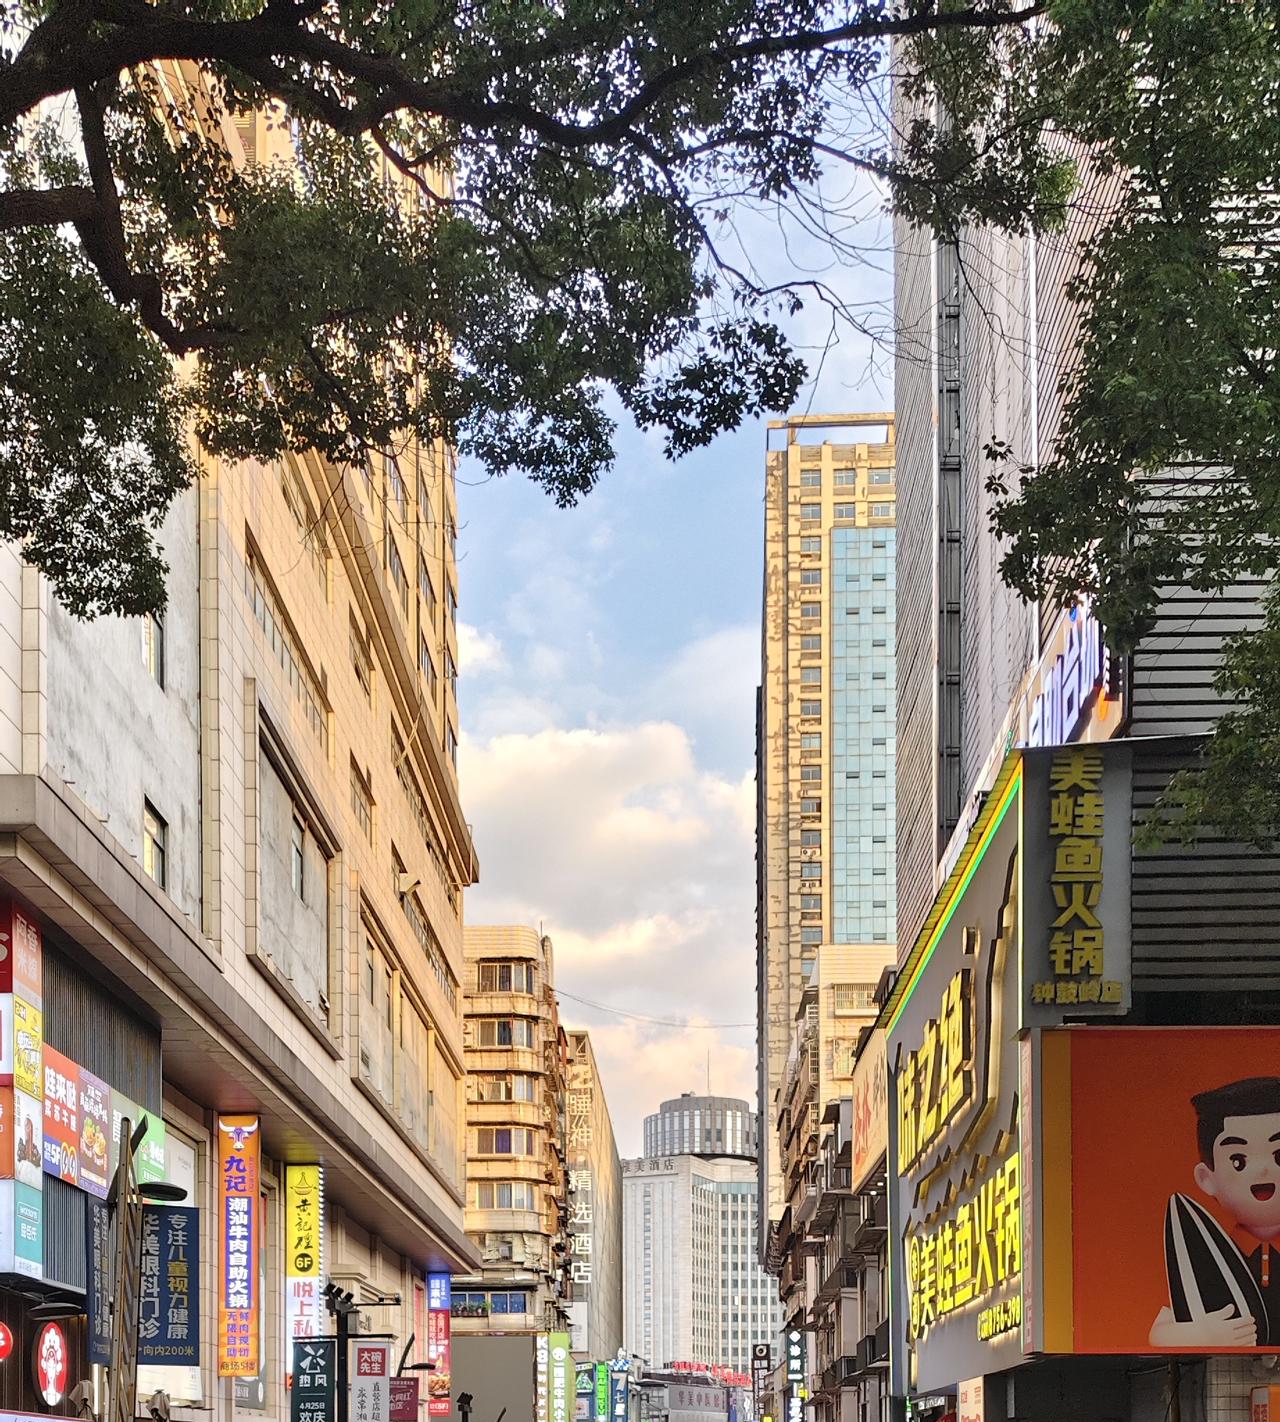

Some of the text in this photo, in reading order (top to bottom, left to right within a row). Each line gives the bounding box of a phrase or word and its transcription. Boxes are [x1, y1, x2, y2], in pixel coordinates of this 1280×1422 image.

[1049, 751, 1104, 975] 美蛙鱼火锅
[224, 1155, 247, 1192] 九记
[228, 1197, 249, 1308] 潮汕牛肉自助火锅
[568, 1168, 593, 1284] 精选酒店
[920, 1152, 1020, 1326] 美蛙鱼火锅
[166, 1213, 189, 1340] 专注儿童视力健康
[295, 1257, 313, 1270] 6F
[299, 1374, 327, 1387] 热风
[360, 1362, 382, 1373] 先生
[361, 1351, 382, 1362] 大碗
